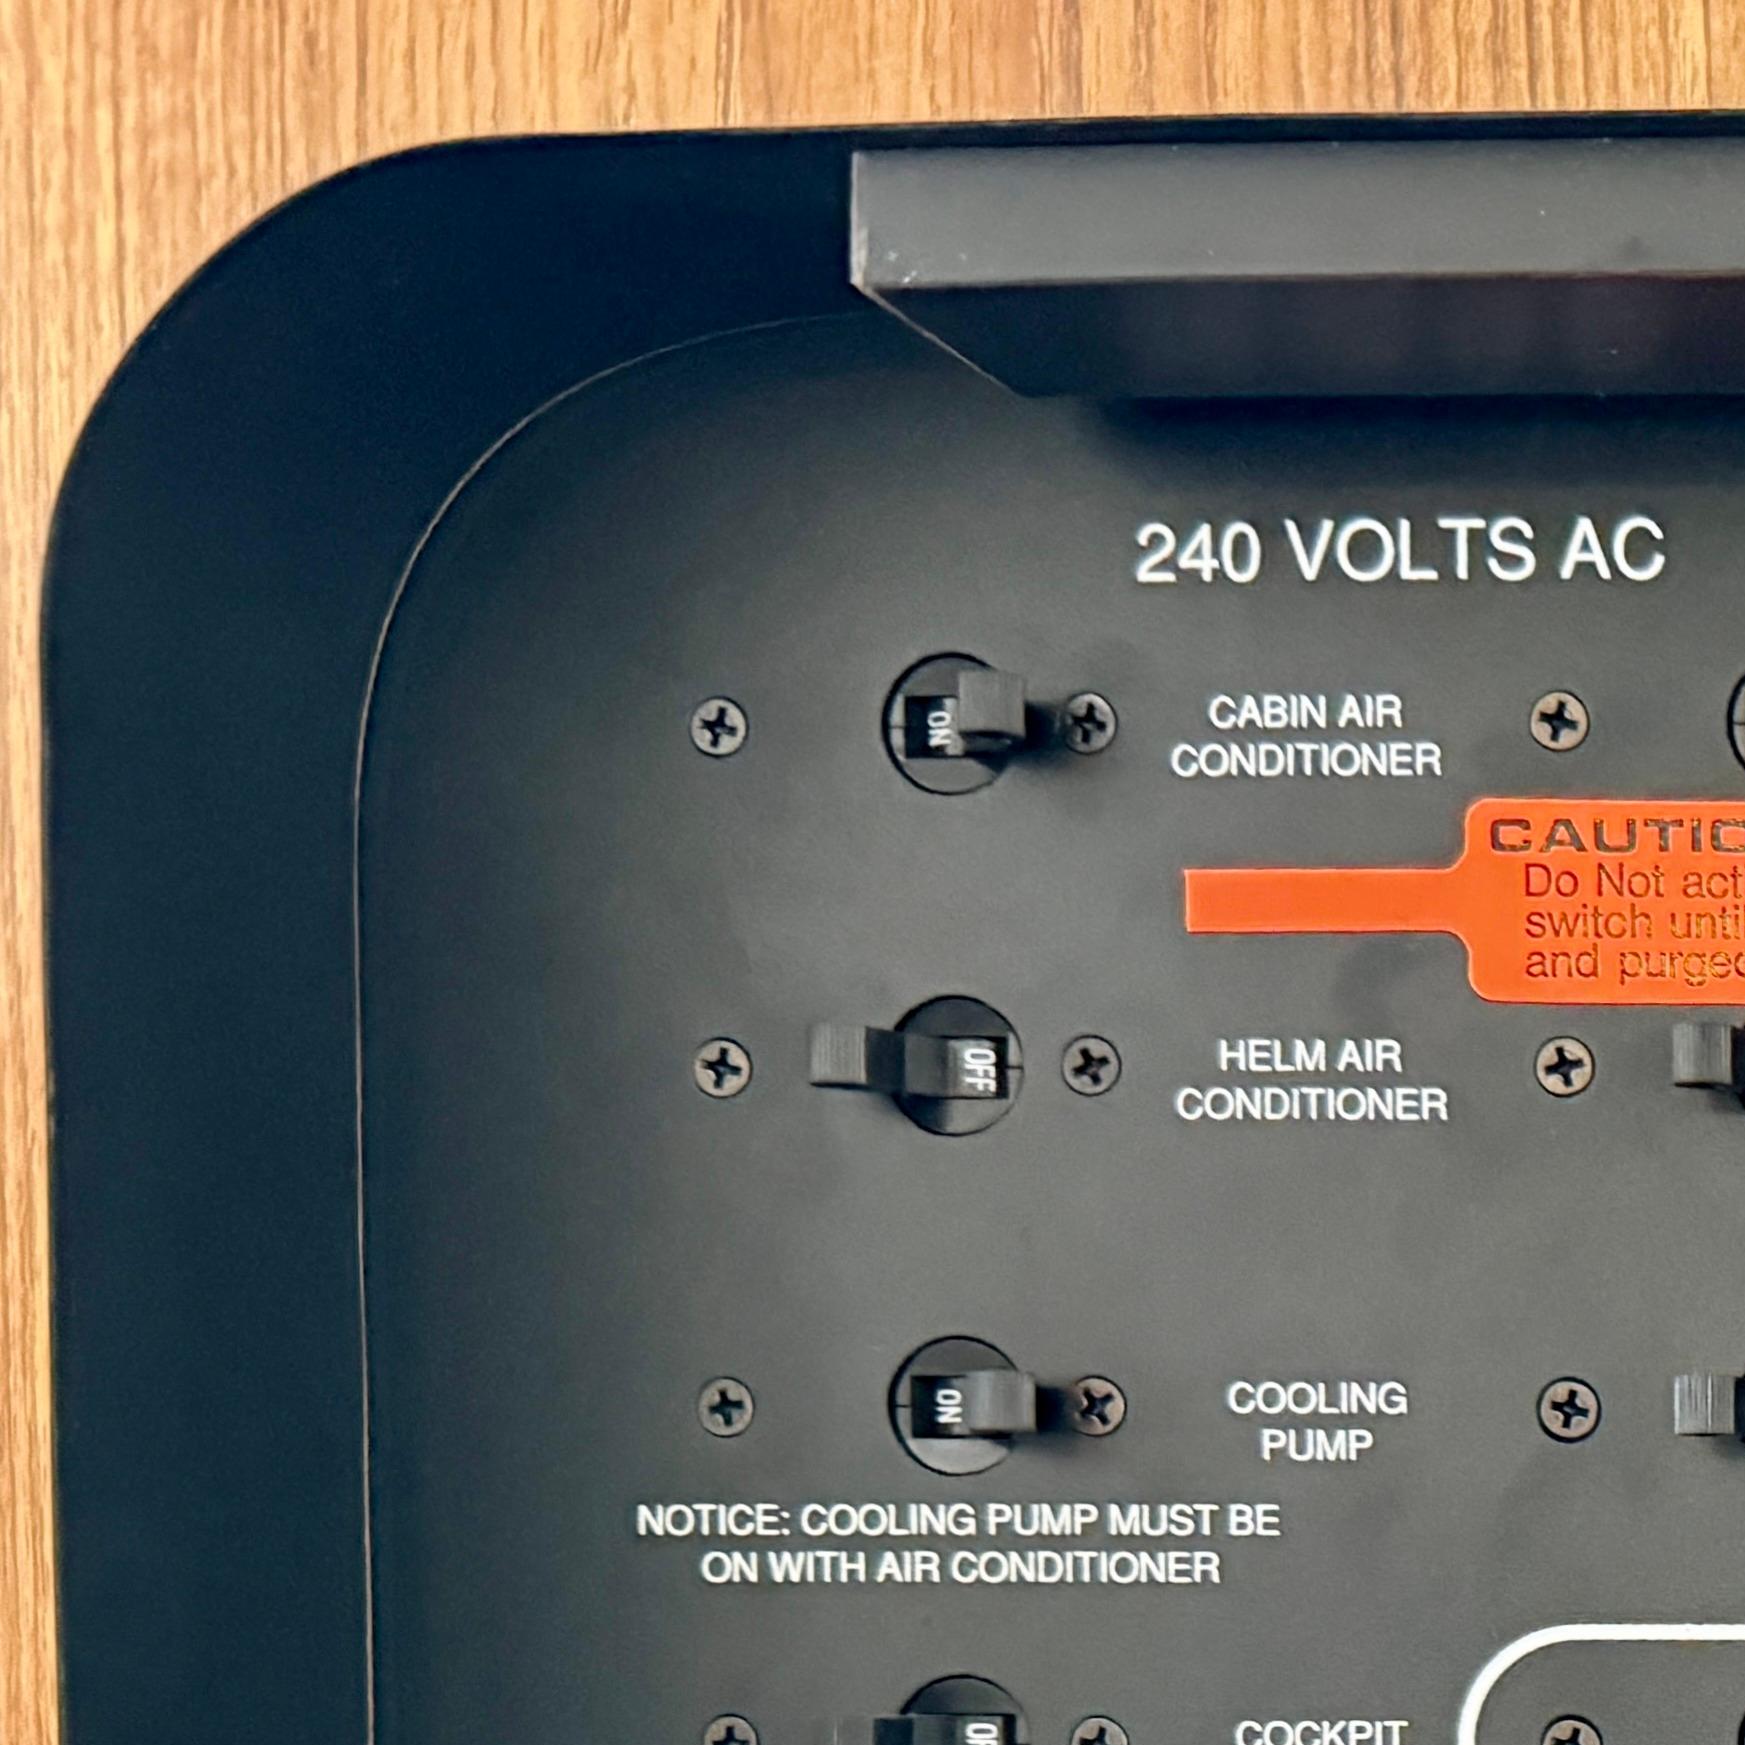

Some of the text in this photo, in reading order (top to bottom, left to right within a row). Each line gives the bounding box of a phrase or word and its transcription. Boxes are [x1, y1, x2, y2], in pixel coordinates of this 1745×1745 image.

[1135, 515, 1666, 583] 240 VOLTS AC
[924, 708, 953, 748] ON
[1208, 693, 1403, 729] CABIN AIR
[1170, 741, 1442, 778] CONDITIONER
[1524, 865, 1578, 899] Do
[1599, 863, 1664, 899] Not
[1525, 905, 1651, 940] switch
[1525, 946, 1598, 979] and
[962, 1048, 996, 1093] OFF
[1219, 1038, 1403, 1073] HELM AIR
[1175, 1086, 1448, 1121] CONDITIONER
[936, 1389, 962, 1424] ON
[1227, 1381, 1408, 1415] COOLING
[1261, 1428, 1374, 1462] PUMP
[637, 1502, 1281, 1537] NOTICE: COOLING PUMP MUST BE
[700, 1550, 1221, 1584] ON WITH AIR CONDITIONER
